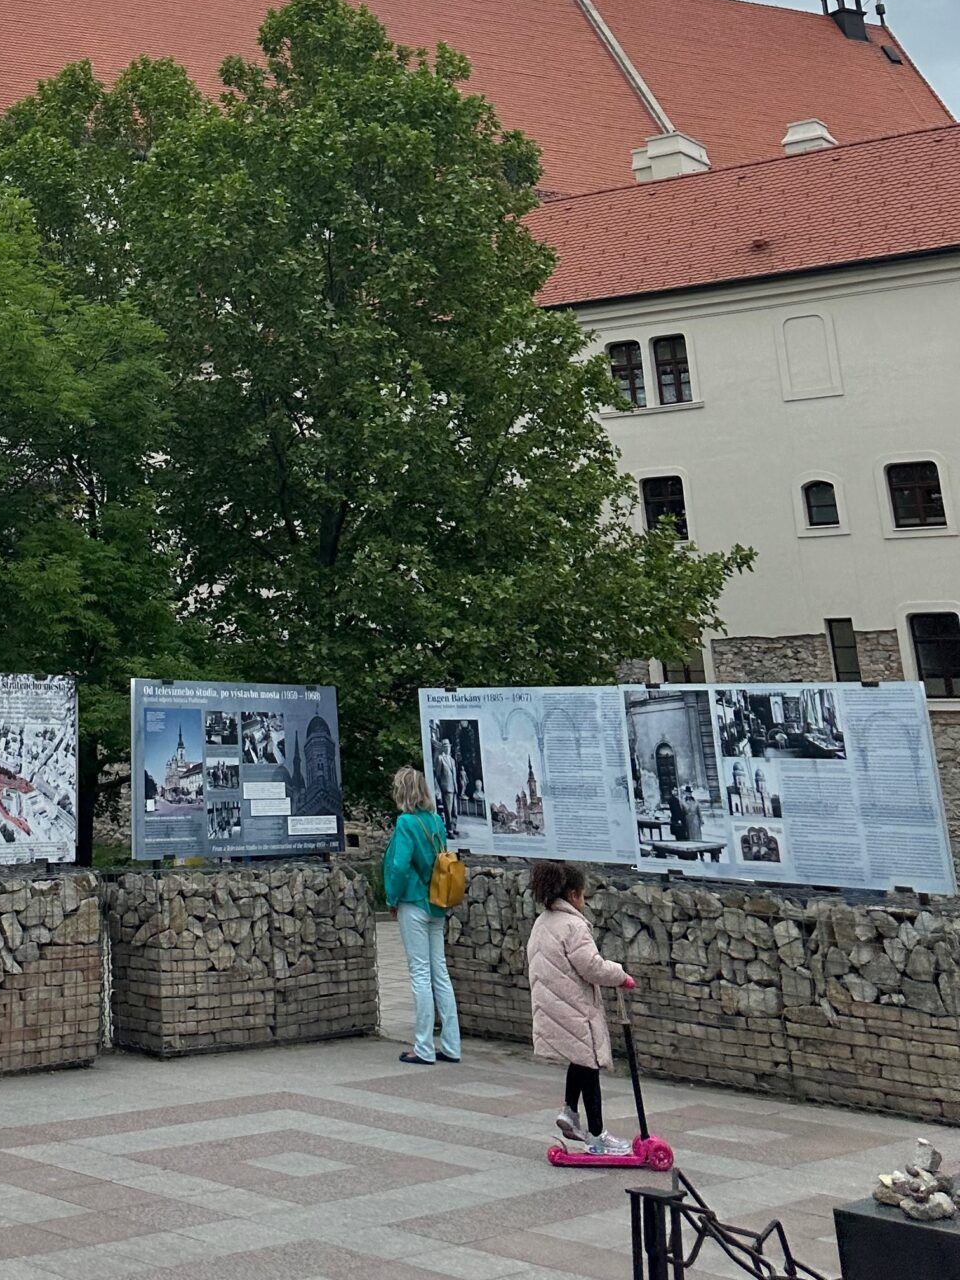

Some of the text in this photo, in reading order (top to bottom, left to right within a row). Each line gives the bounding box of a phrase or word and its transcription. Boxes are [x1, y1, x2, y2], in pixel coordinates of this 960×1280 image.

[143, 685, 154, 695] Od
[220, 689, 229, 699] po
[426, 694, 450, 704] Eugen
